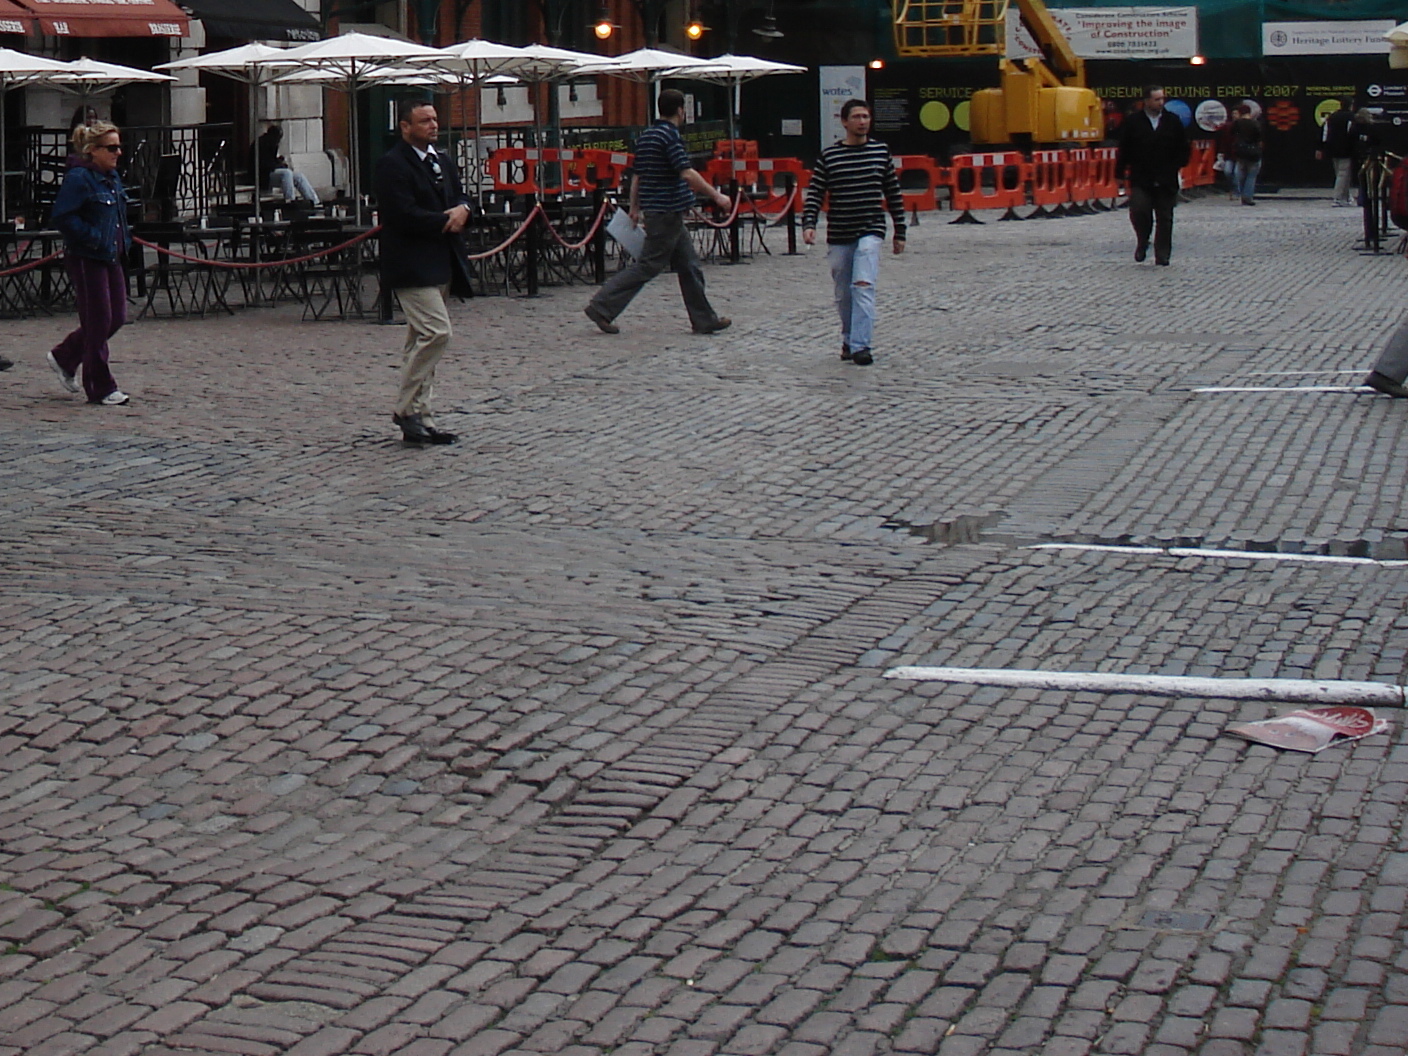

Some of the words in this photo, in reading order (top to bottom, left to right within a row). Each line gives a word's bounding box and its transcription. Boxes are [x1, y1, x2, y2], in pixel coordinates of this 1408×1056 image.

[1136, 19, 1153, 28] the
[1156, 18, 1187, 30] image
[1091, 30, 1101, 39] of
[1292, 36, 1329, 46] Heritage
[1332, 35, 1362, 46] Lottery
[822, 87, 853, 95] wates
[919, 87, 973, 98] SERVICE
[1164, 86, 1211, 98] RIVING
[1216, 86, 1261, 97] EARLY
[1263, 85, 1300, 97] 2007
